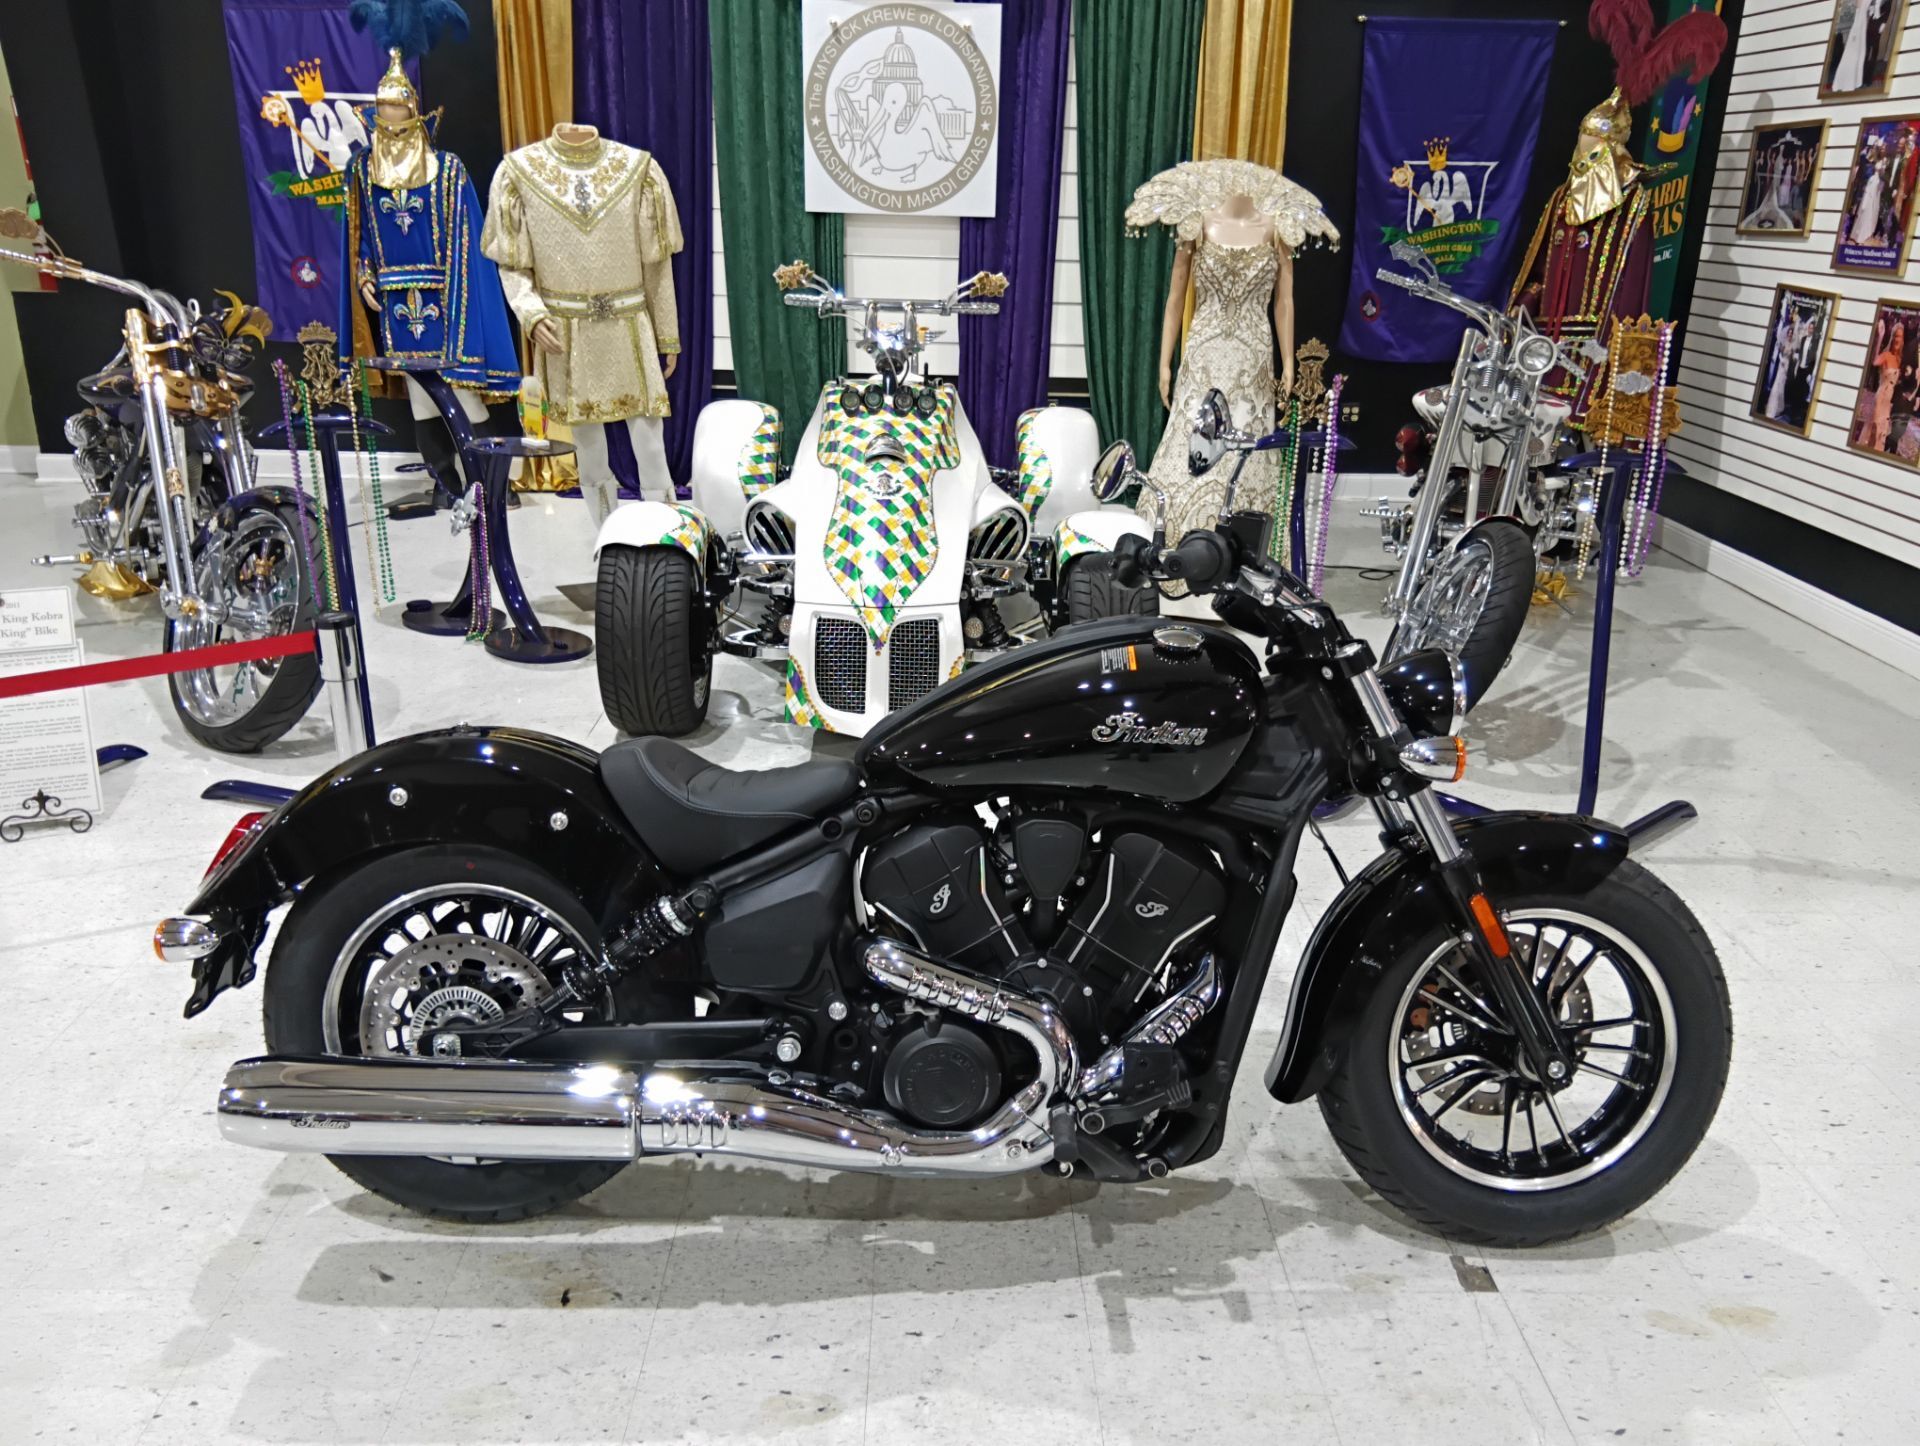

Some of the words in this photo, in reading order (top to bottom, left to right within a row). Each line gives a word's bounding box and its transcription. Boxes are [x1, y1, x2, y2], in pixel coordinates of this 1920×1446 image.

[862, 7, 916, 26] KREWE
[919, 14, 935, 26] of
[815, 21, 862, 80] MYSTICK
[935, 18, 993, 116] LOUISIANIANS
[809, 82, 823, 110] The
[813, 131, 903, 209] WASHINGTON
[907, 178, 958, 209] MARDI
[956, 136, 988, 180] GRAS
[289, 173, 344, 196] WASHI
[1653, 174, 1689, 209] ARDI
[316, 195, 344, 204] MAR
[1407, 223, 1482, 244] WASHINGTON
[31, 610, 63, 621] Kobra
[35, 626, 58, 635] Bike
[1091, 712, 1208, 746] Indian
[297, 1114, 346, 1129] Indian
